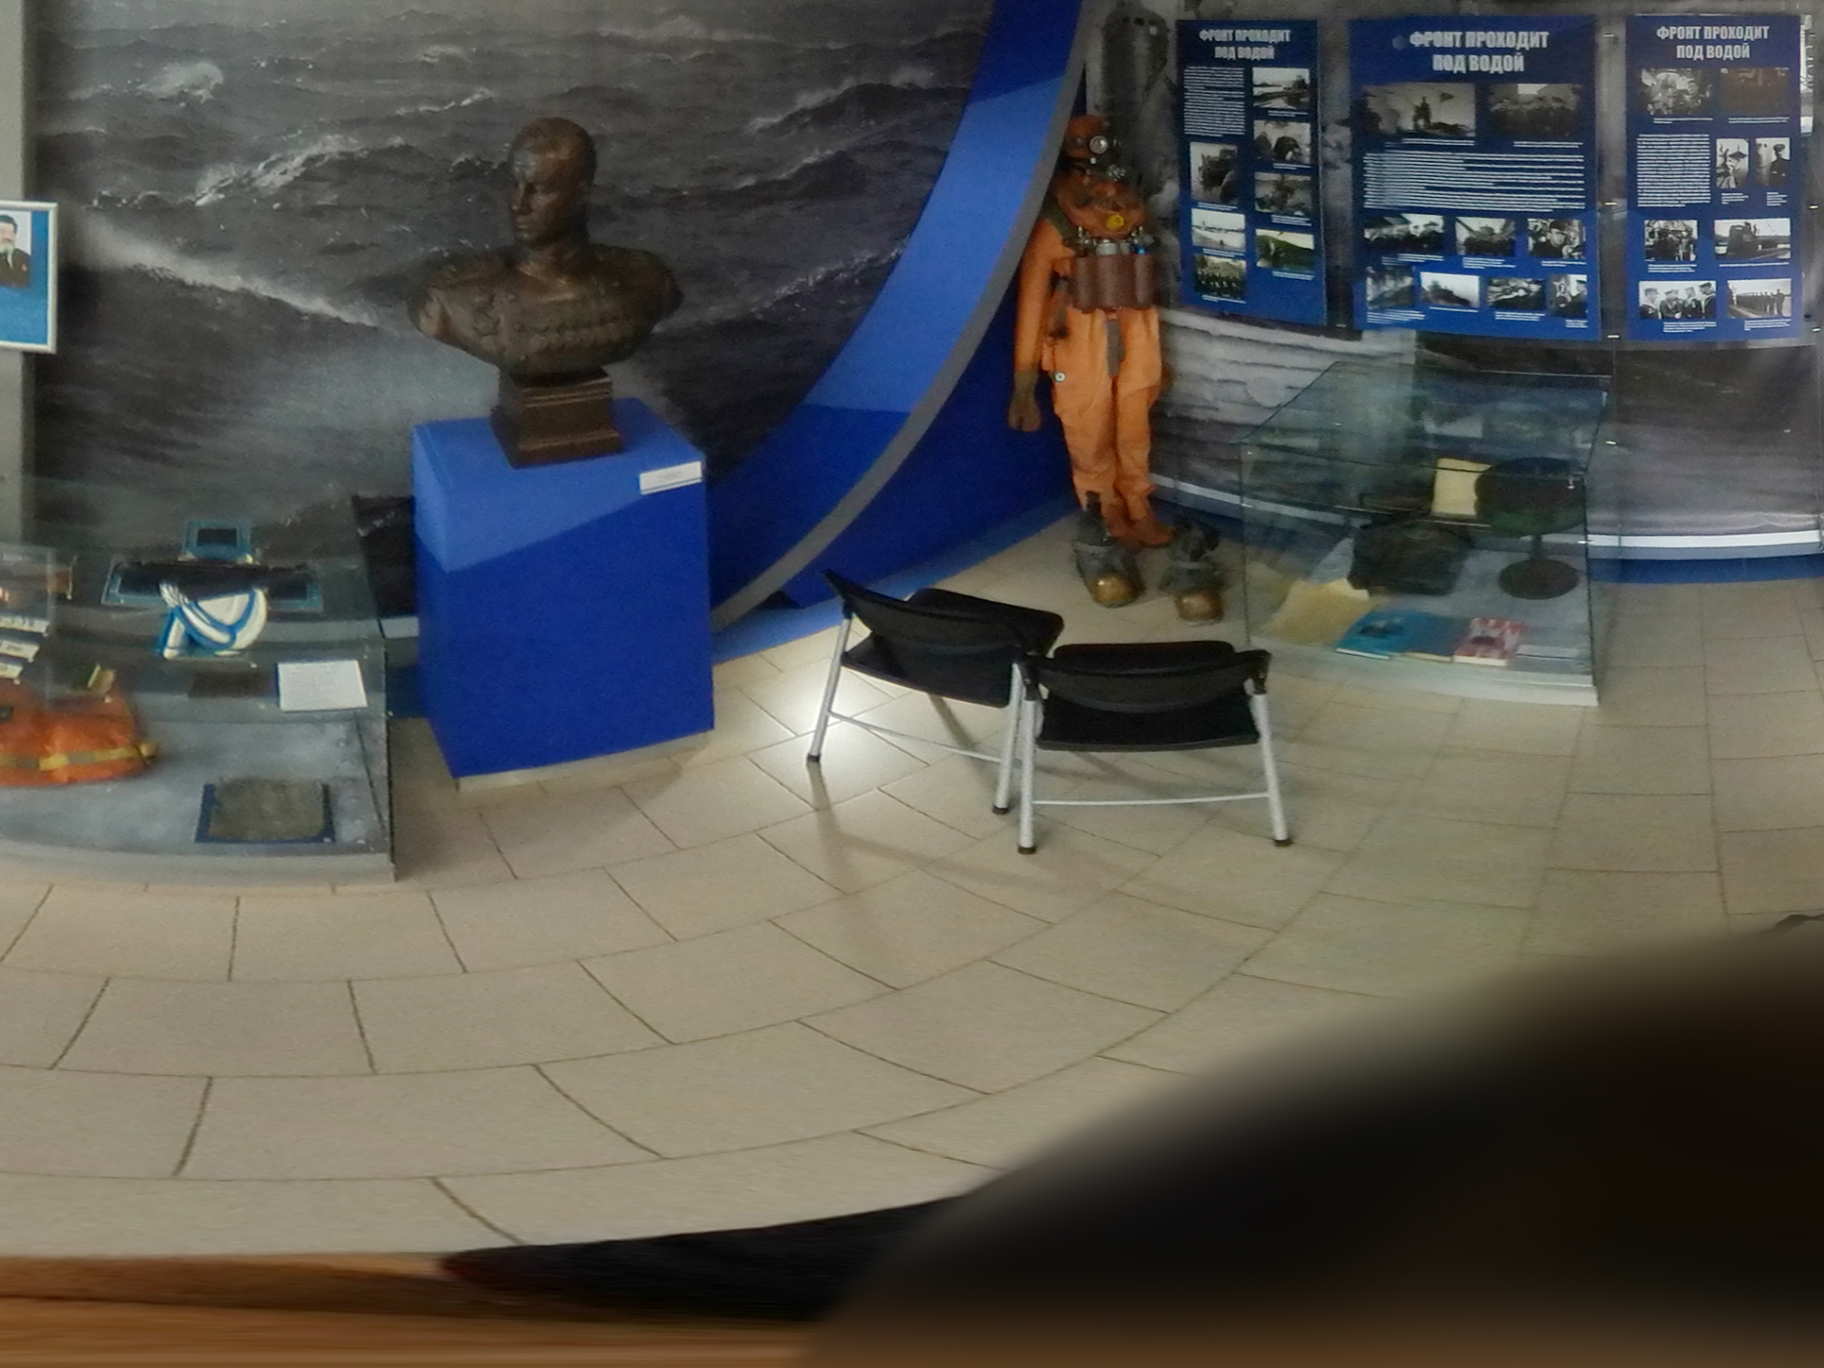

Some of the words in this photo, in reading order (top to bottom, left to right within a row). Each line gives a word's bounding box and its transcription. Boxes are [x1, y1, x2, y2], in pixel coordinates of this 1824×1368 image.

[1199, 28, 1234, 42] ФРОНТ
[1235, 29, 1292, 44] ПРОХОДИТ
[1409, 30, 1464, 48] ФРОНТ
[1465, 30, 1550, 51] ПРОХОДИТ
[1656, 25, 1702, 40] ФРОНТ
[1703, 25, 1770, 42] ПРОХОДИТ
[1214, 45, 1237, 61] ПОД
[1237, 44, 1275, 61] ВОДОЙ
[1676, 44, 1705, 61] ПОД
[1705, 41, 1751, 61] ВОДОЙ
[1432, 53, 1467, 74] ПОД
[1468, 51, 1525, 74] ВОДОЙ
